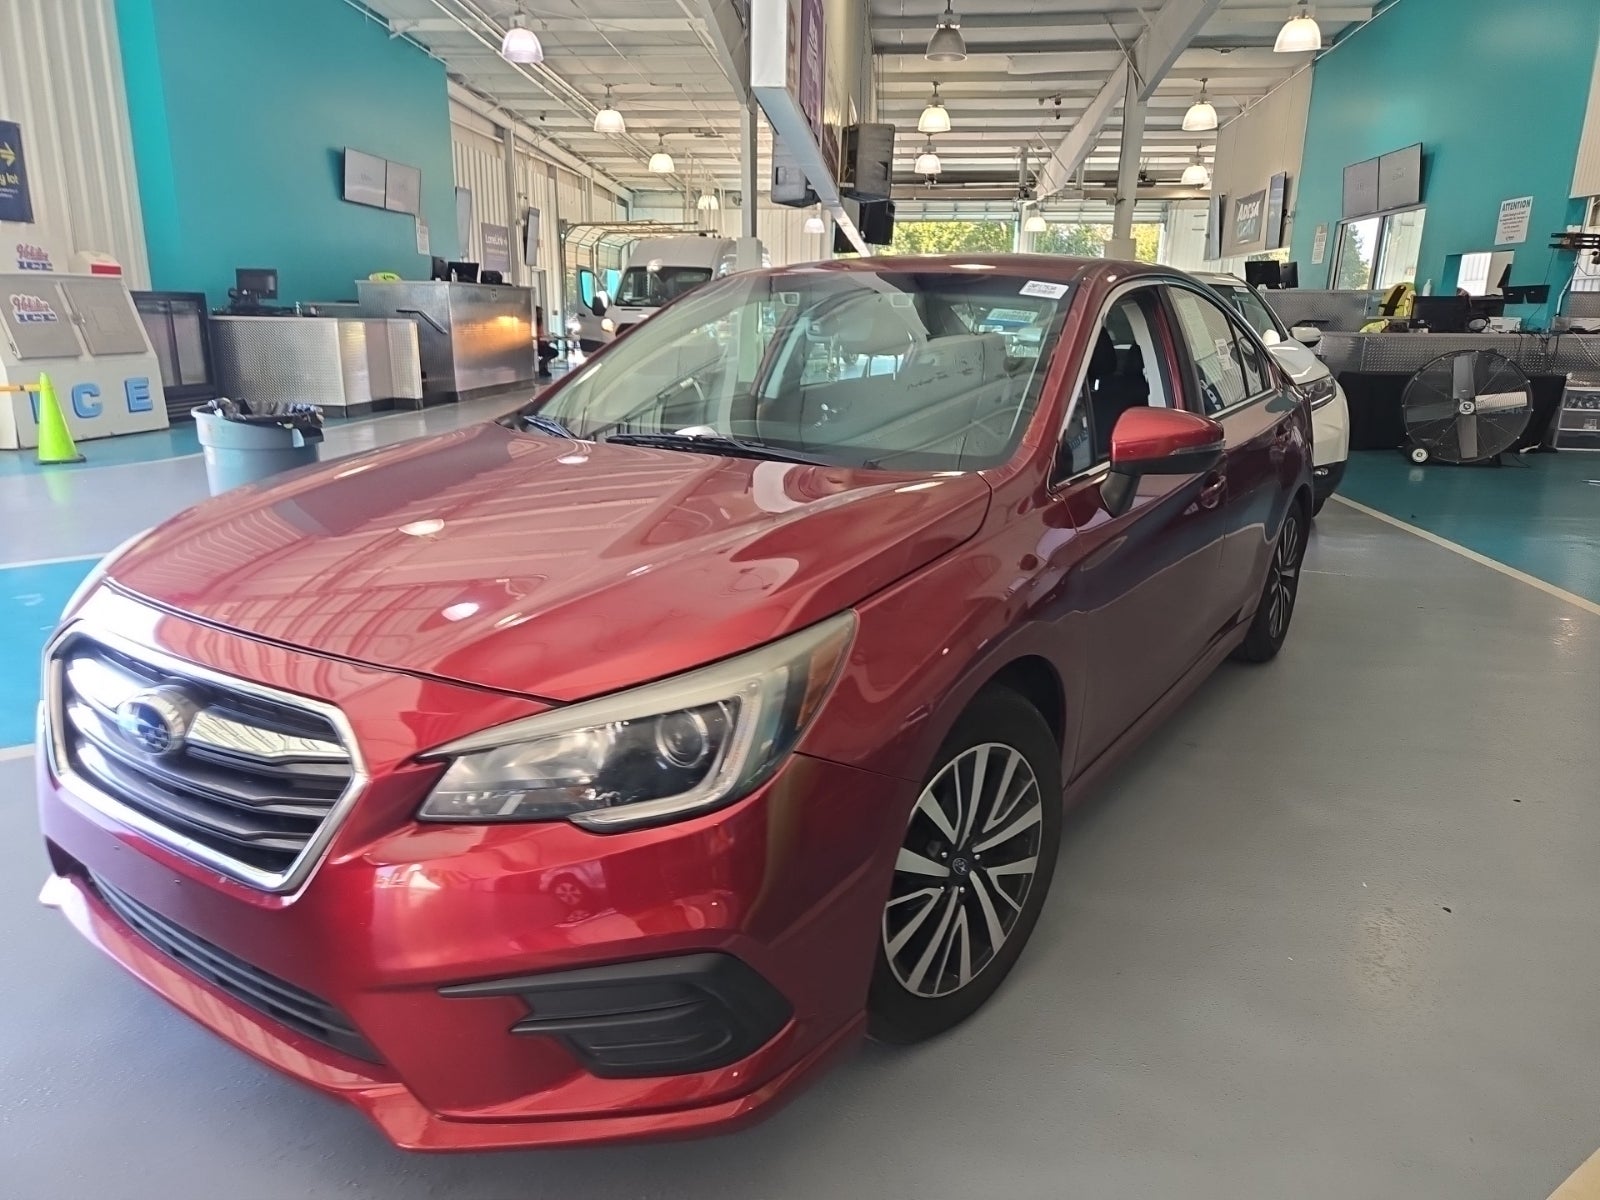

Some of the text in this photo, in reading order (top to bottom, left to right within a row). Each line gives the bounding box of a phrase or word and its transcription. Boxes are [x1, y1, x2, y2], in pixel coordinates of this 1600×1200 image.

[1502, 199, 1531, 211] ATTENTION
[18, 260, 54, 272] ICE
[16, 312, 58, 322] ICE
